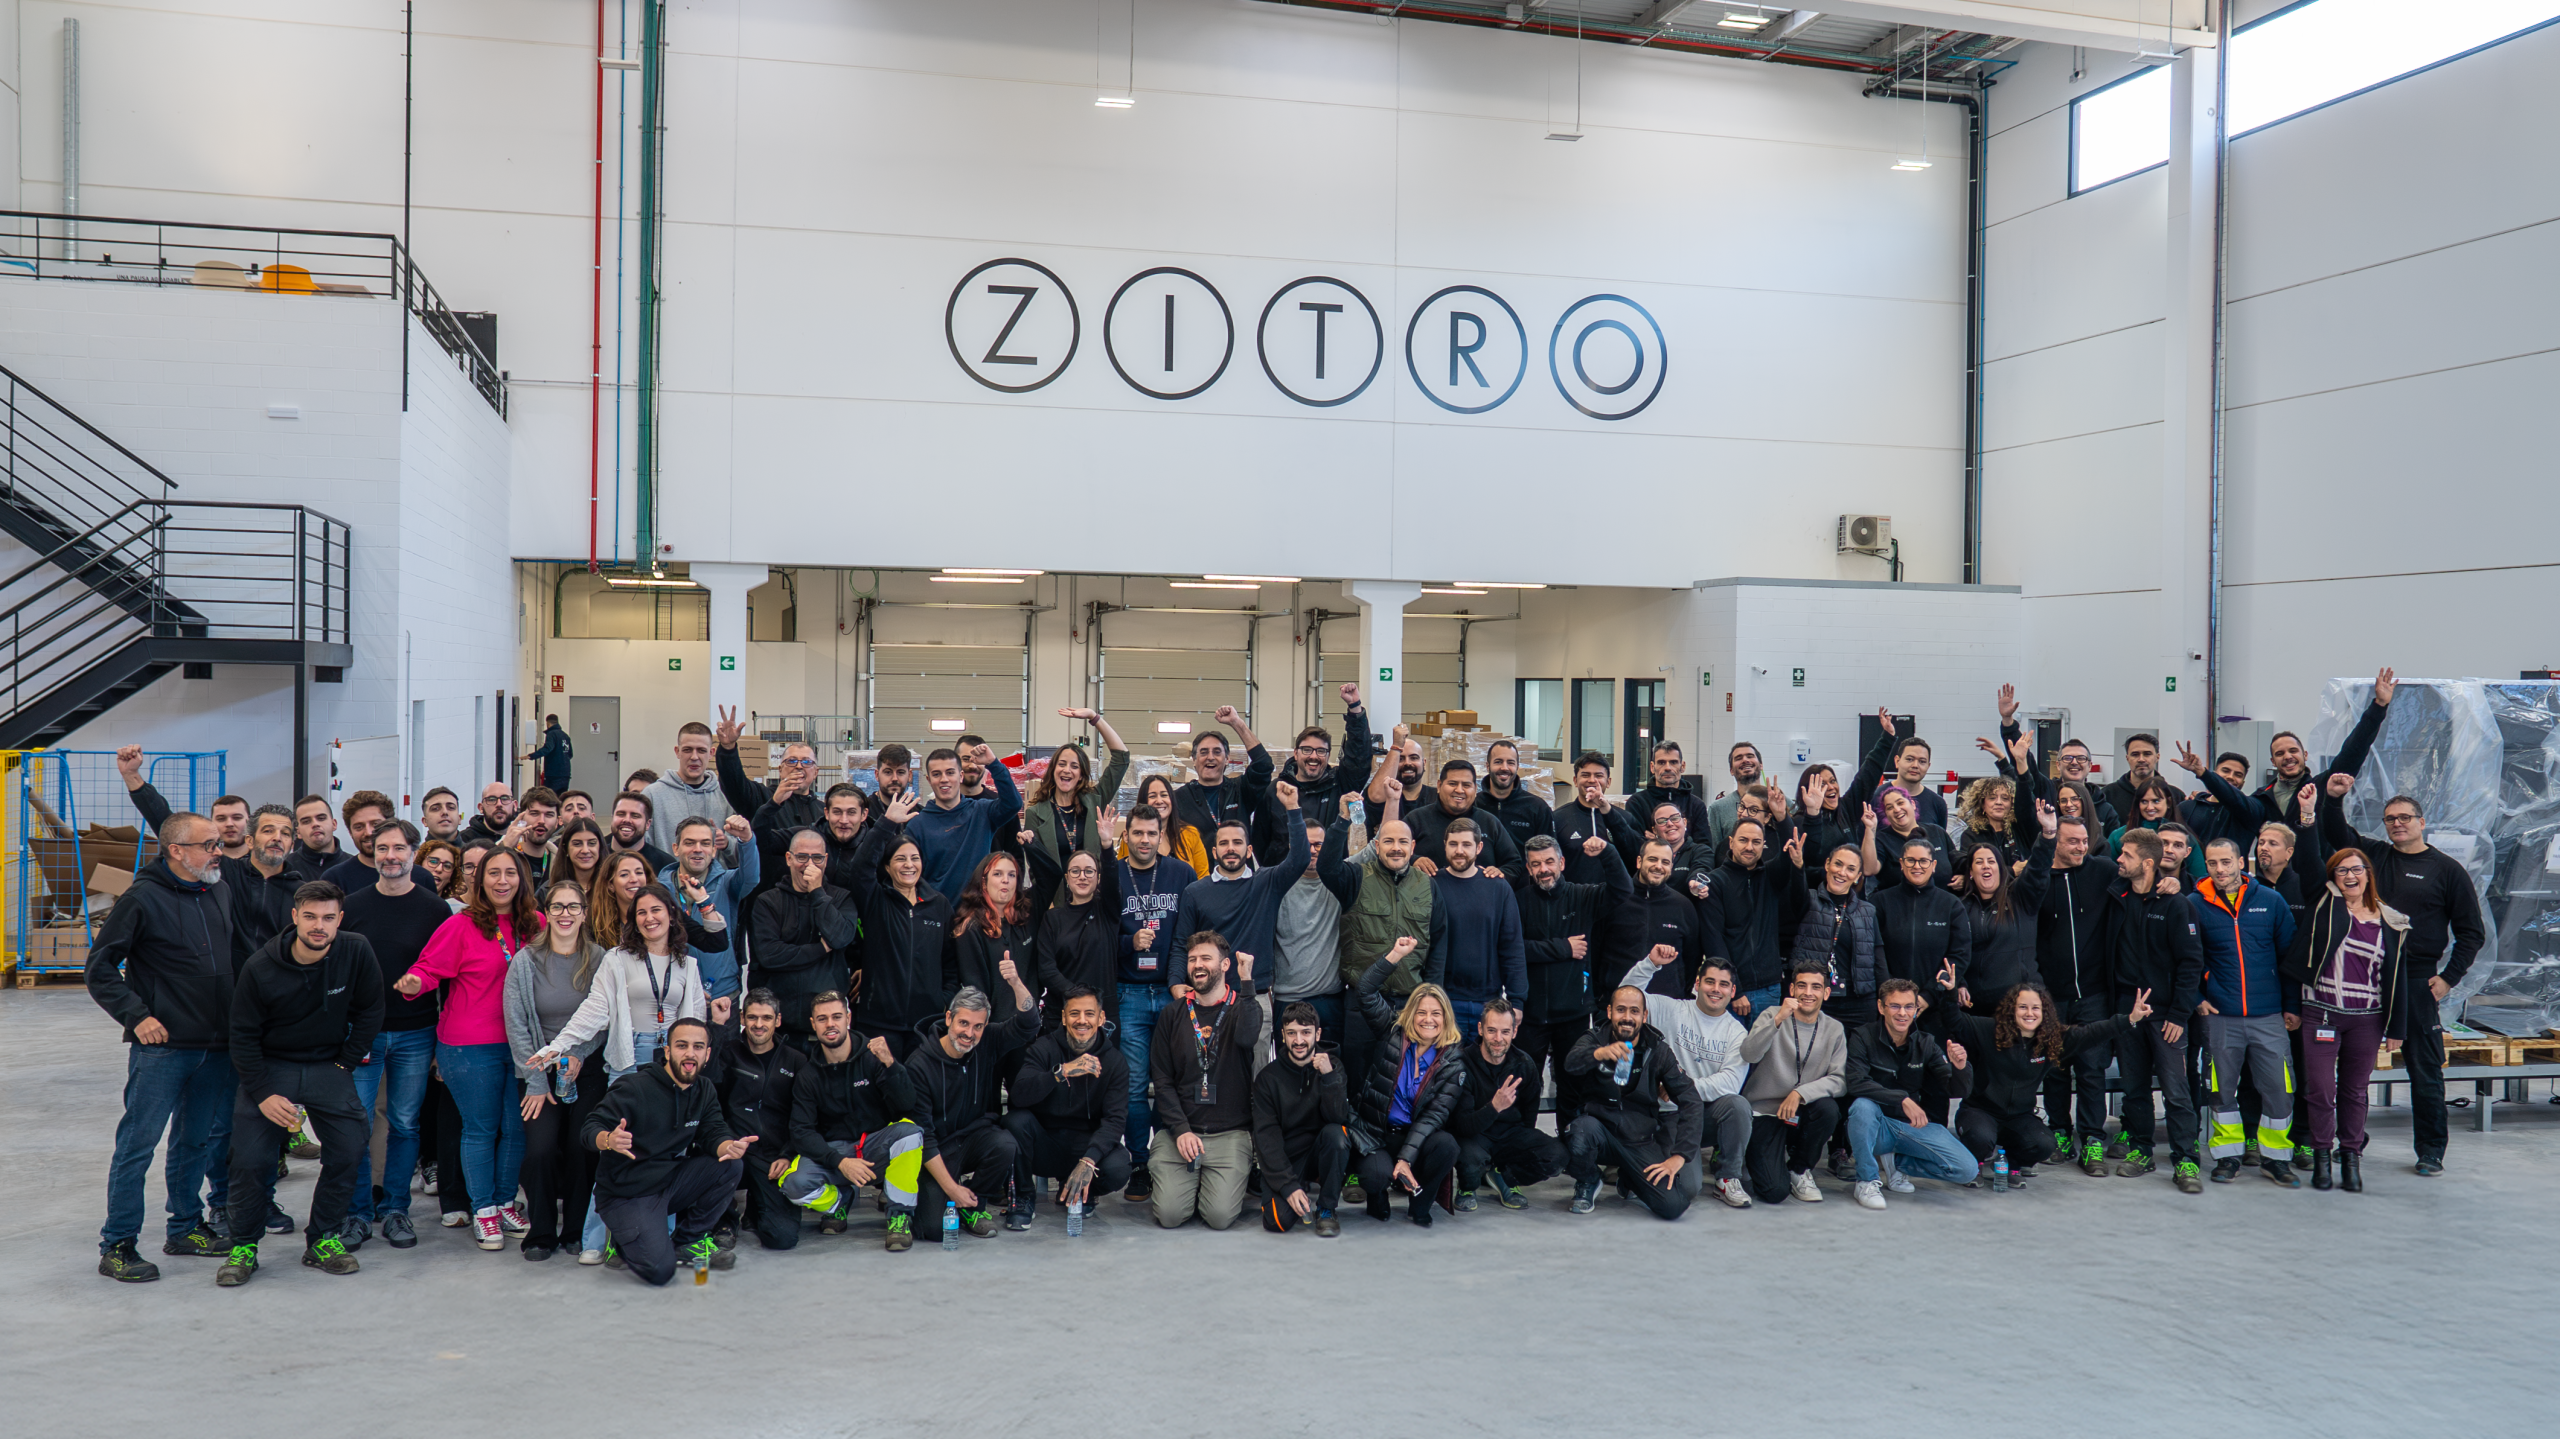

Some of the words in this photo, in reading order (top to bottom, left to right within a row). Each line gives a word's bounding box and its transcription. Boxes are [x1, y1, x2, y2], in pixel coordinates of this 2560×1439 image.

[981, 283, 1645, 396] ZITRO
[1135, 910, 1167, 920] ENLAND
[1675, 1037, 1704, 1056] ATHLEC
